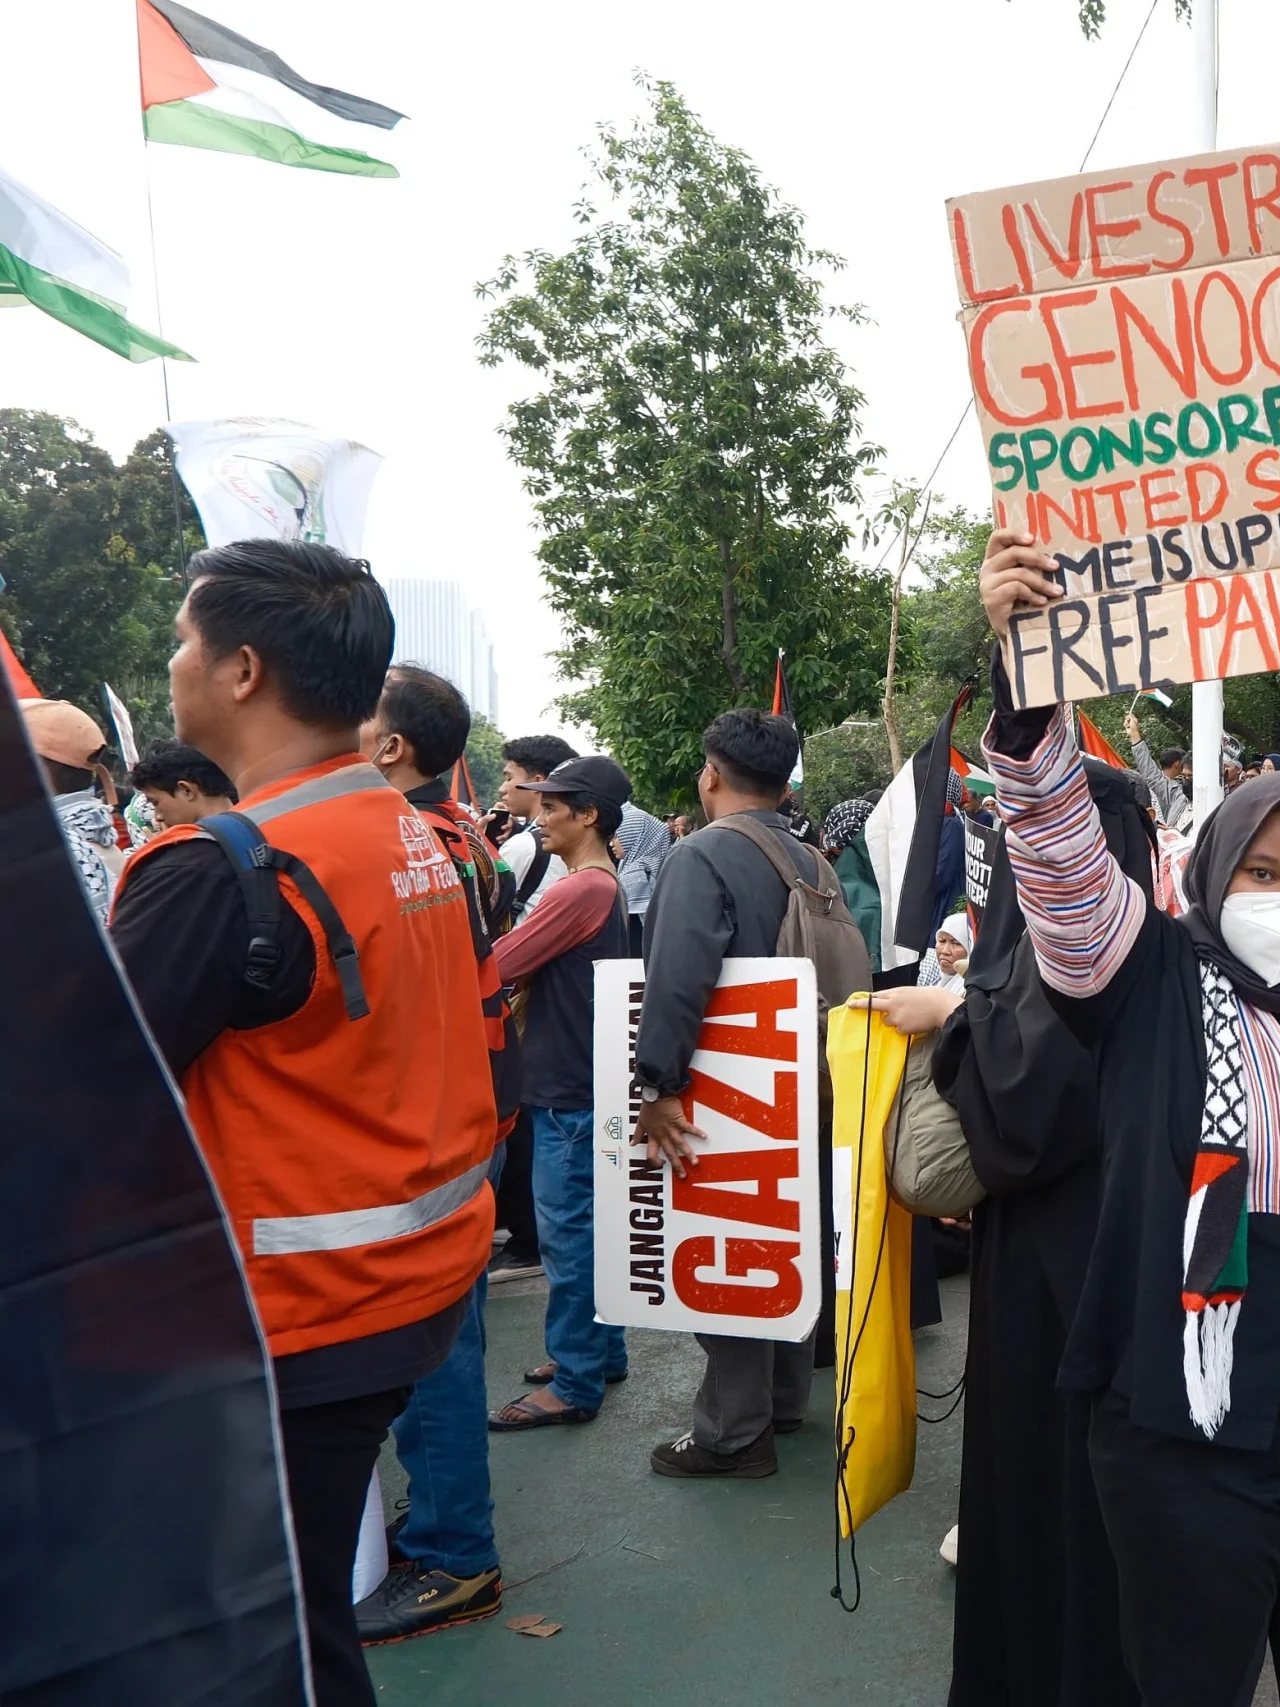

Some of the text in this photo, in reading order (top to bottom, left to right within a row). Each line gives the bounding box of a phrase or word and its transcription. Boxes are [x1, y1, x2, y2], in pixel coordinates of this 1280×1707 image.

[997, 463, 1229, 546] UNITED
[1041, 540, 1137, 597] ME
[1151, 530, 1193, 583] IS
[1008, 586, 1176, 710] FREE
[966, 830, 985, 860] OUR
[672, 978, 804, 1319] GAZA
[629, 1157, 665, 1307] JANGAN
[417, 1588, 439, 1604] FILA
